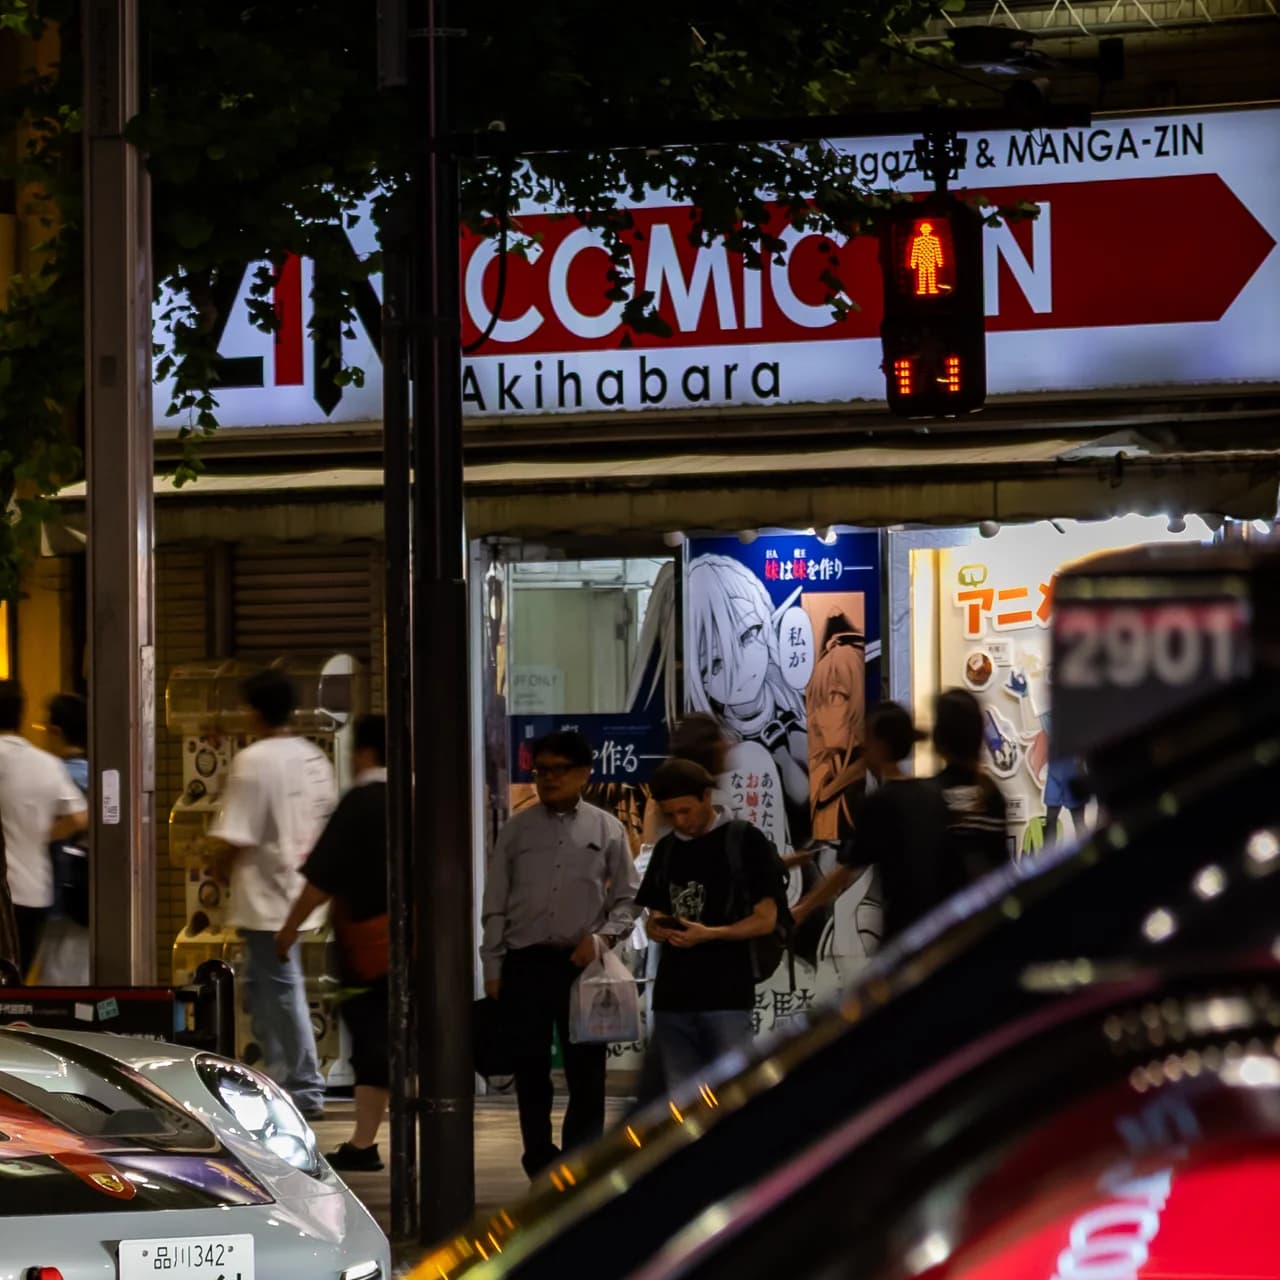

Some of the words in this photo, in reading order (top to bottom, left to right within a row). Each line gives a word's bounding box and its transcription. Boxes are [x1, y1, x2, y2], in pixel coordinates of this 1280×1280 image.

[1006, 122, 1204, 167] MANGA-ZIN
[462, 355, 782, 412] Akihabara
[787, 624, 808, 670] 私が
[154, 1246, 191, 1270] 品川
[193, 1243, 226, 1267] 342
